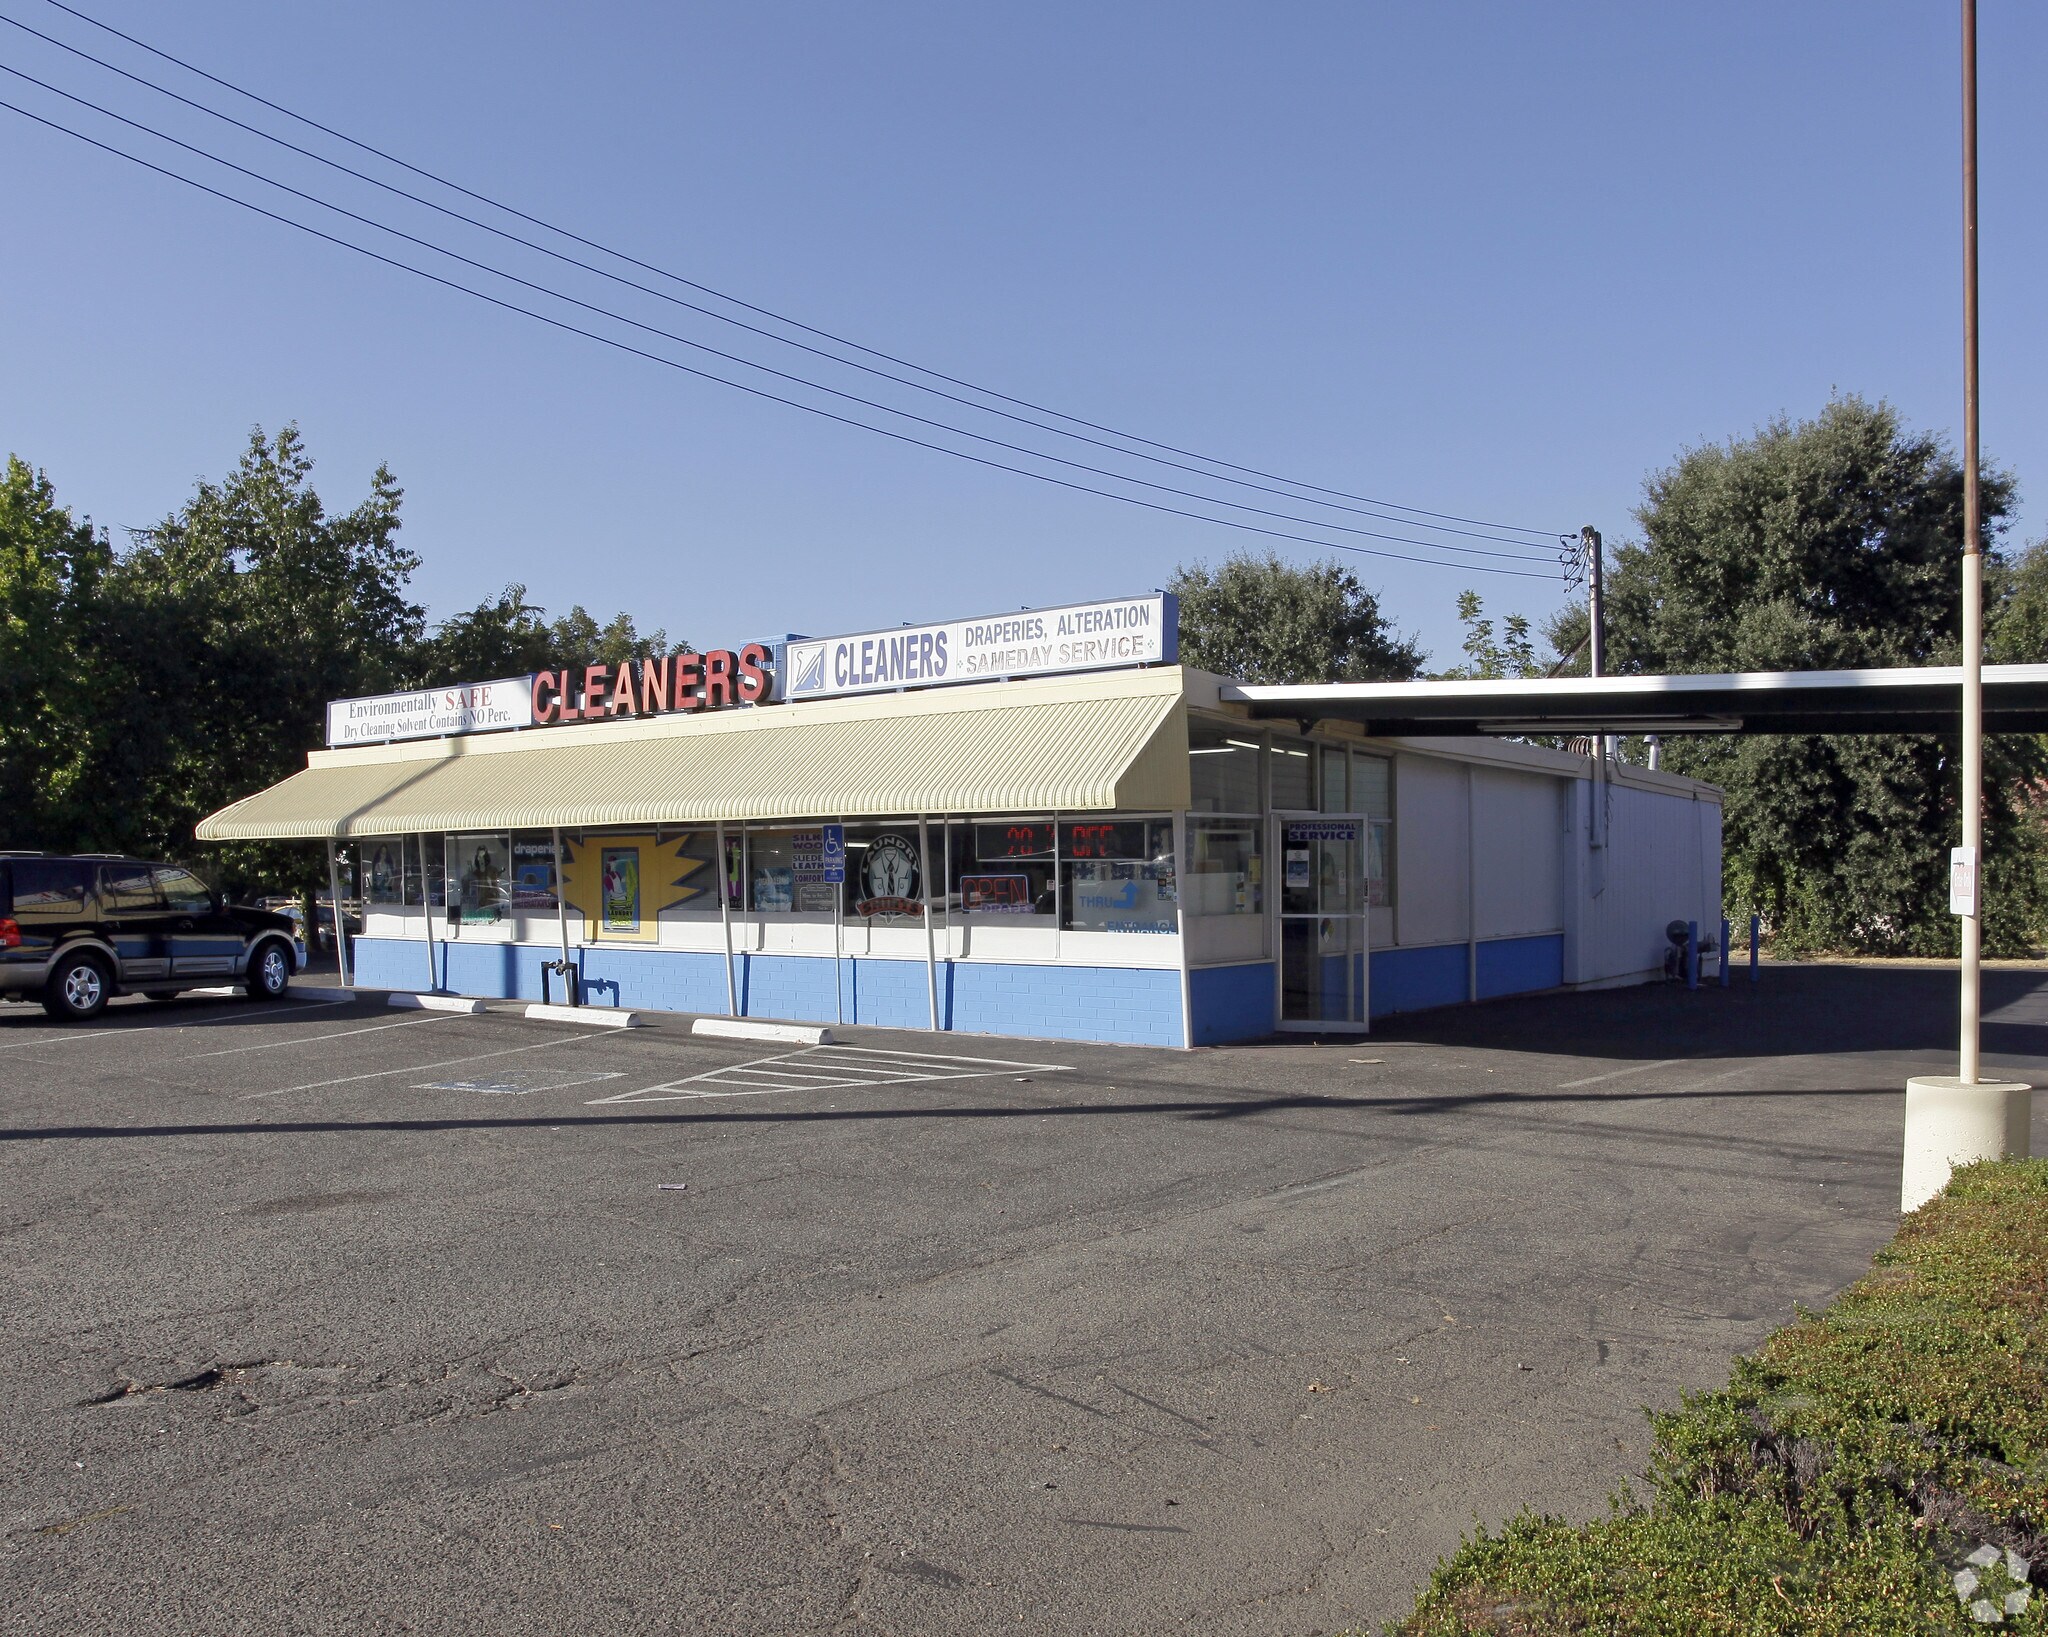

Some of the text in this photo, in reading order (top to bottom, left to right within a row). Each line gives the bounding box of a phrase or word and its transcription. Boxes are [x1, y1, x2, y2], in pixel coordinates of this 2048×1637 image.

[965, 603, 1150, 648] DRAPERIES, ALTERATION
[835, 630, 948, 688] CLEANERS
[966, 635, 1144, 675] SAMEDAY SERVICE
[532, 642, 771, 723] CLEANERS
[348, 685, 493, 720] Environmentally SAFE
[343, 707, 511, 741] Dry Cleaning Solvent Contains NO Perc.
[792, 833, 822, 842] SILK
[1289, 823, 1356, 831] PROFESSIONAL
[1289, 831, 1356, 840] SERVICE
[792, 842, 823, 850] WOO
[862, 836, 920, 874] LAUNDRY
[863, 898, 919, 913] SHIRTS
[963, 878, 1027, 910] OPEN
[1079, 895, 1113, 909] THRU
